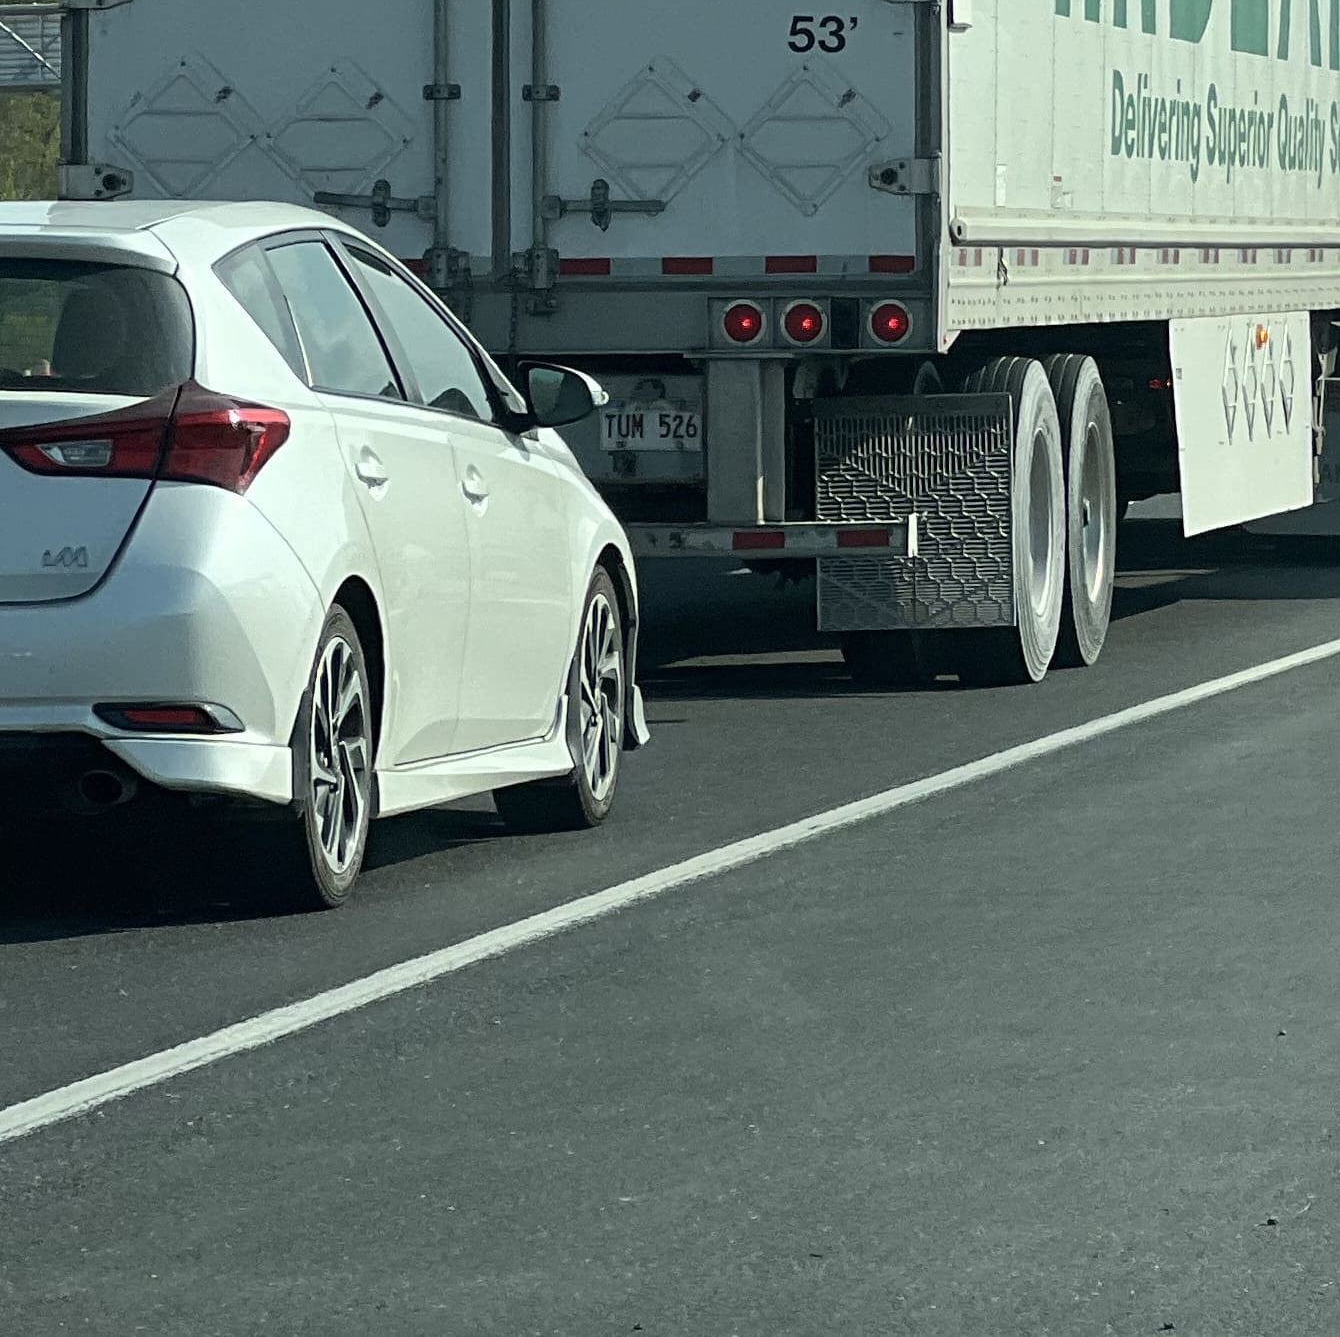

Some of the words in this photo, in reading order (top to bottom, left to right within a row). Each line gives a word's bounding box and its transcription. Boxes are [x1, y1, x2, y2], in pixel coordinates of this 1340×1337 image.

[788, 15, 858, 54] 53'
[1111, 69, 1201, 183] Delivering
[1206, 82, 1274, 184] Superior
[1278, 93, 1326, 189] Quality
[658, 413, 698, 439] 526
